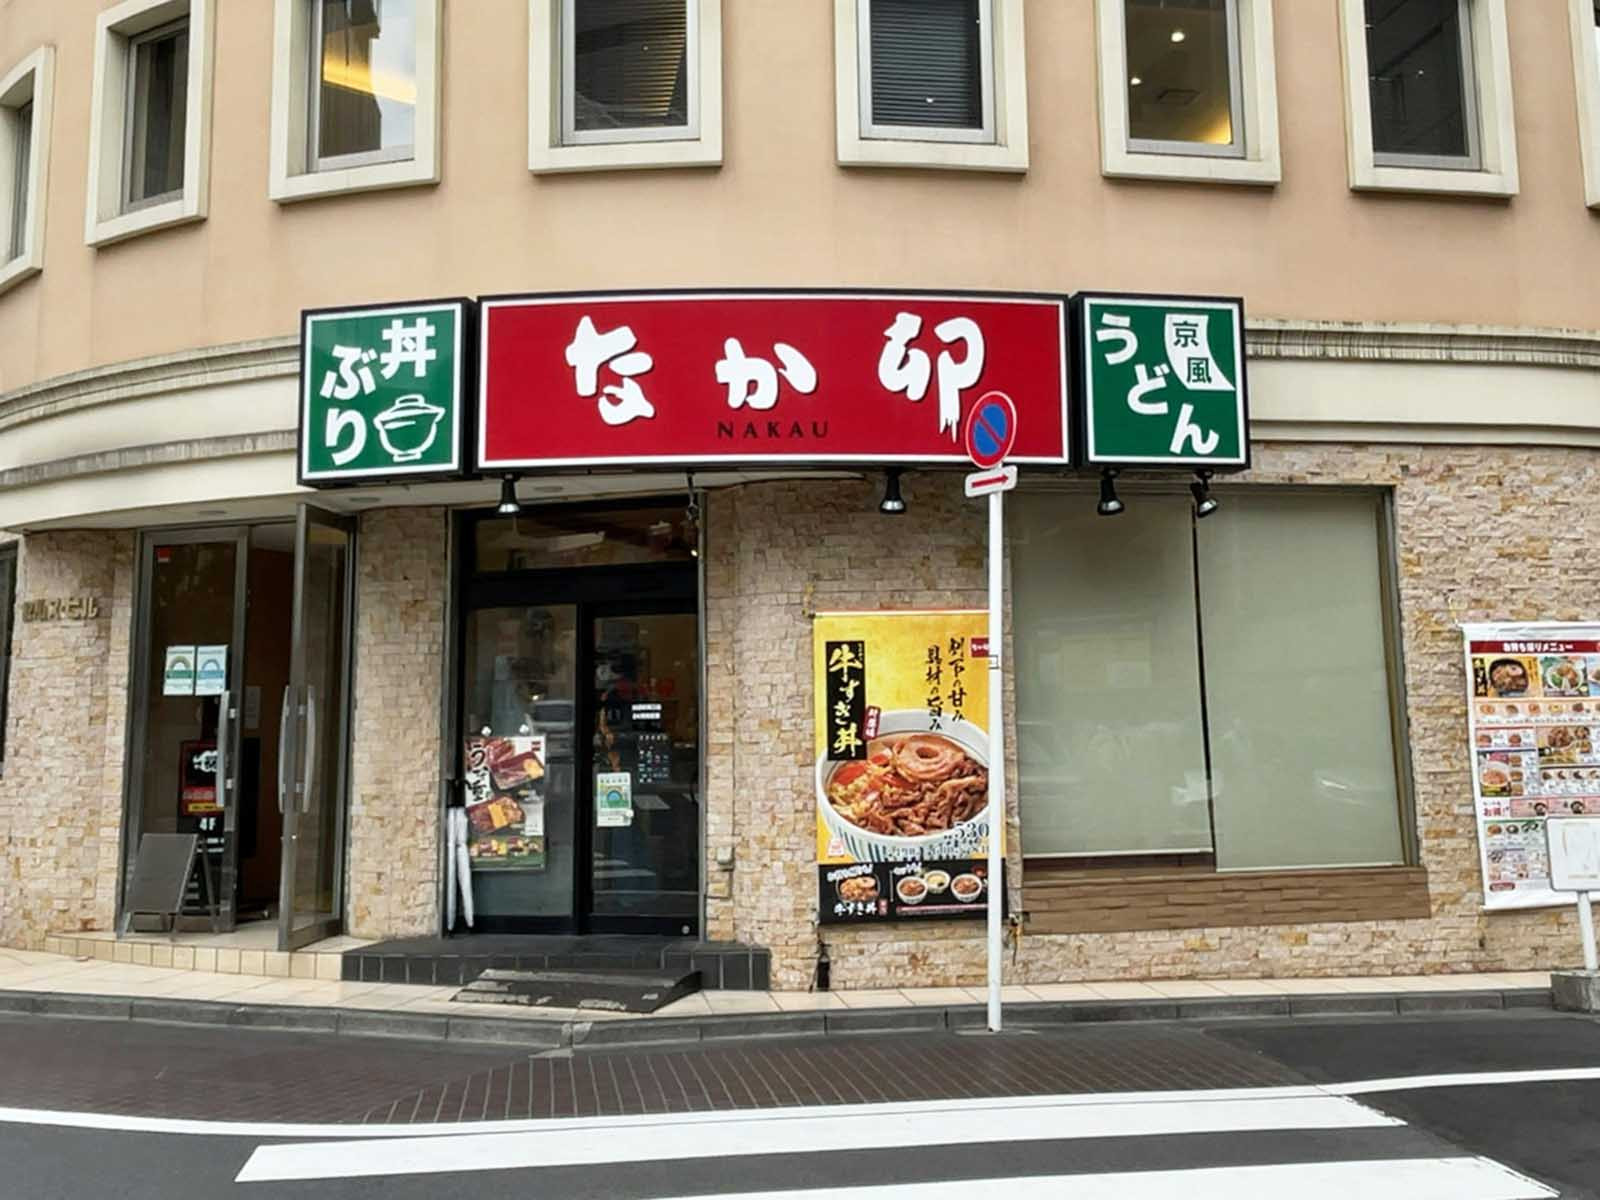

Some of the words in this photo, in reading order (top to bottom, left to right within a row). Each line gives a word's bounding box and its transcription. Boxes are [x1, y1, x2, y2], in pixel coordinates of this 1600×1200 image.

[320, 317, 437, 466] 丼ぶり
[564, 311, 986, 444] なか卯
[1095, 312, 1220, 456] うどん
[1171, 320, 1213, 385] 京風
[717, 421, 829, 439] NAKAU
[199, 817, 217, 831] 4F
